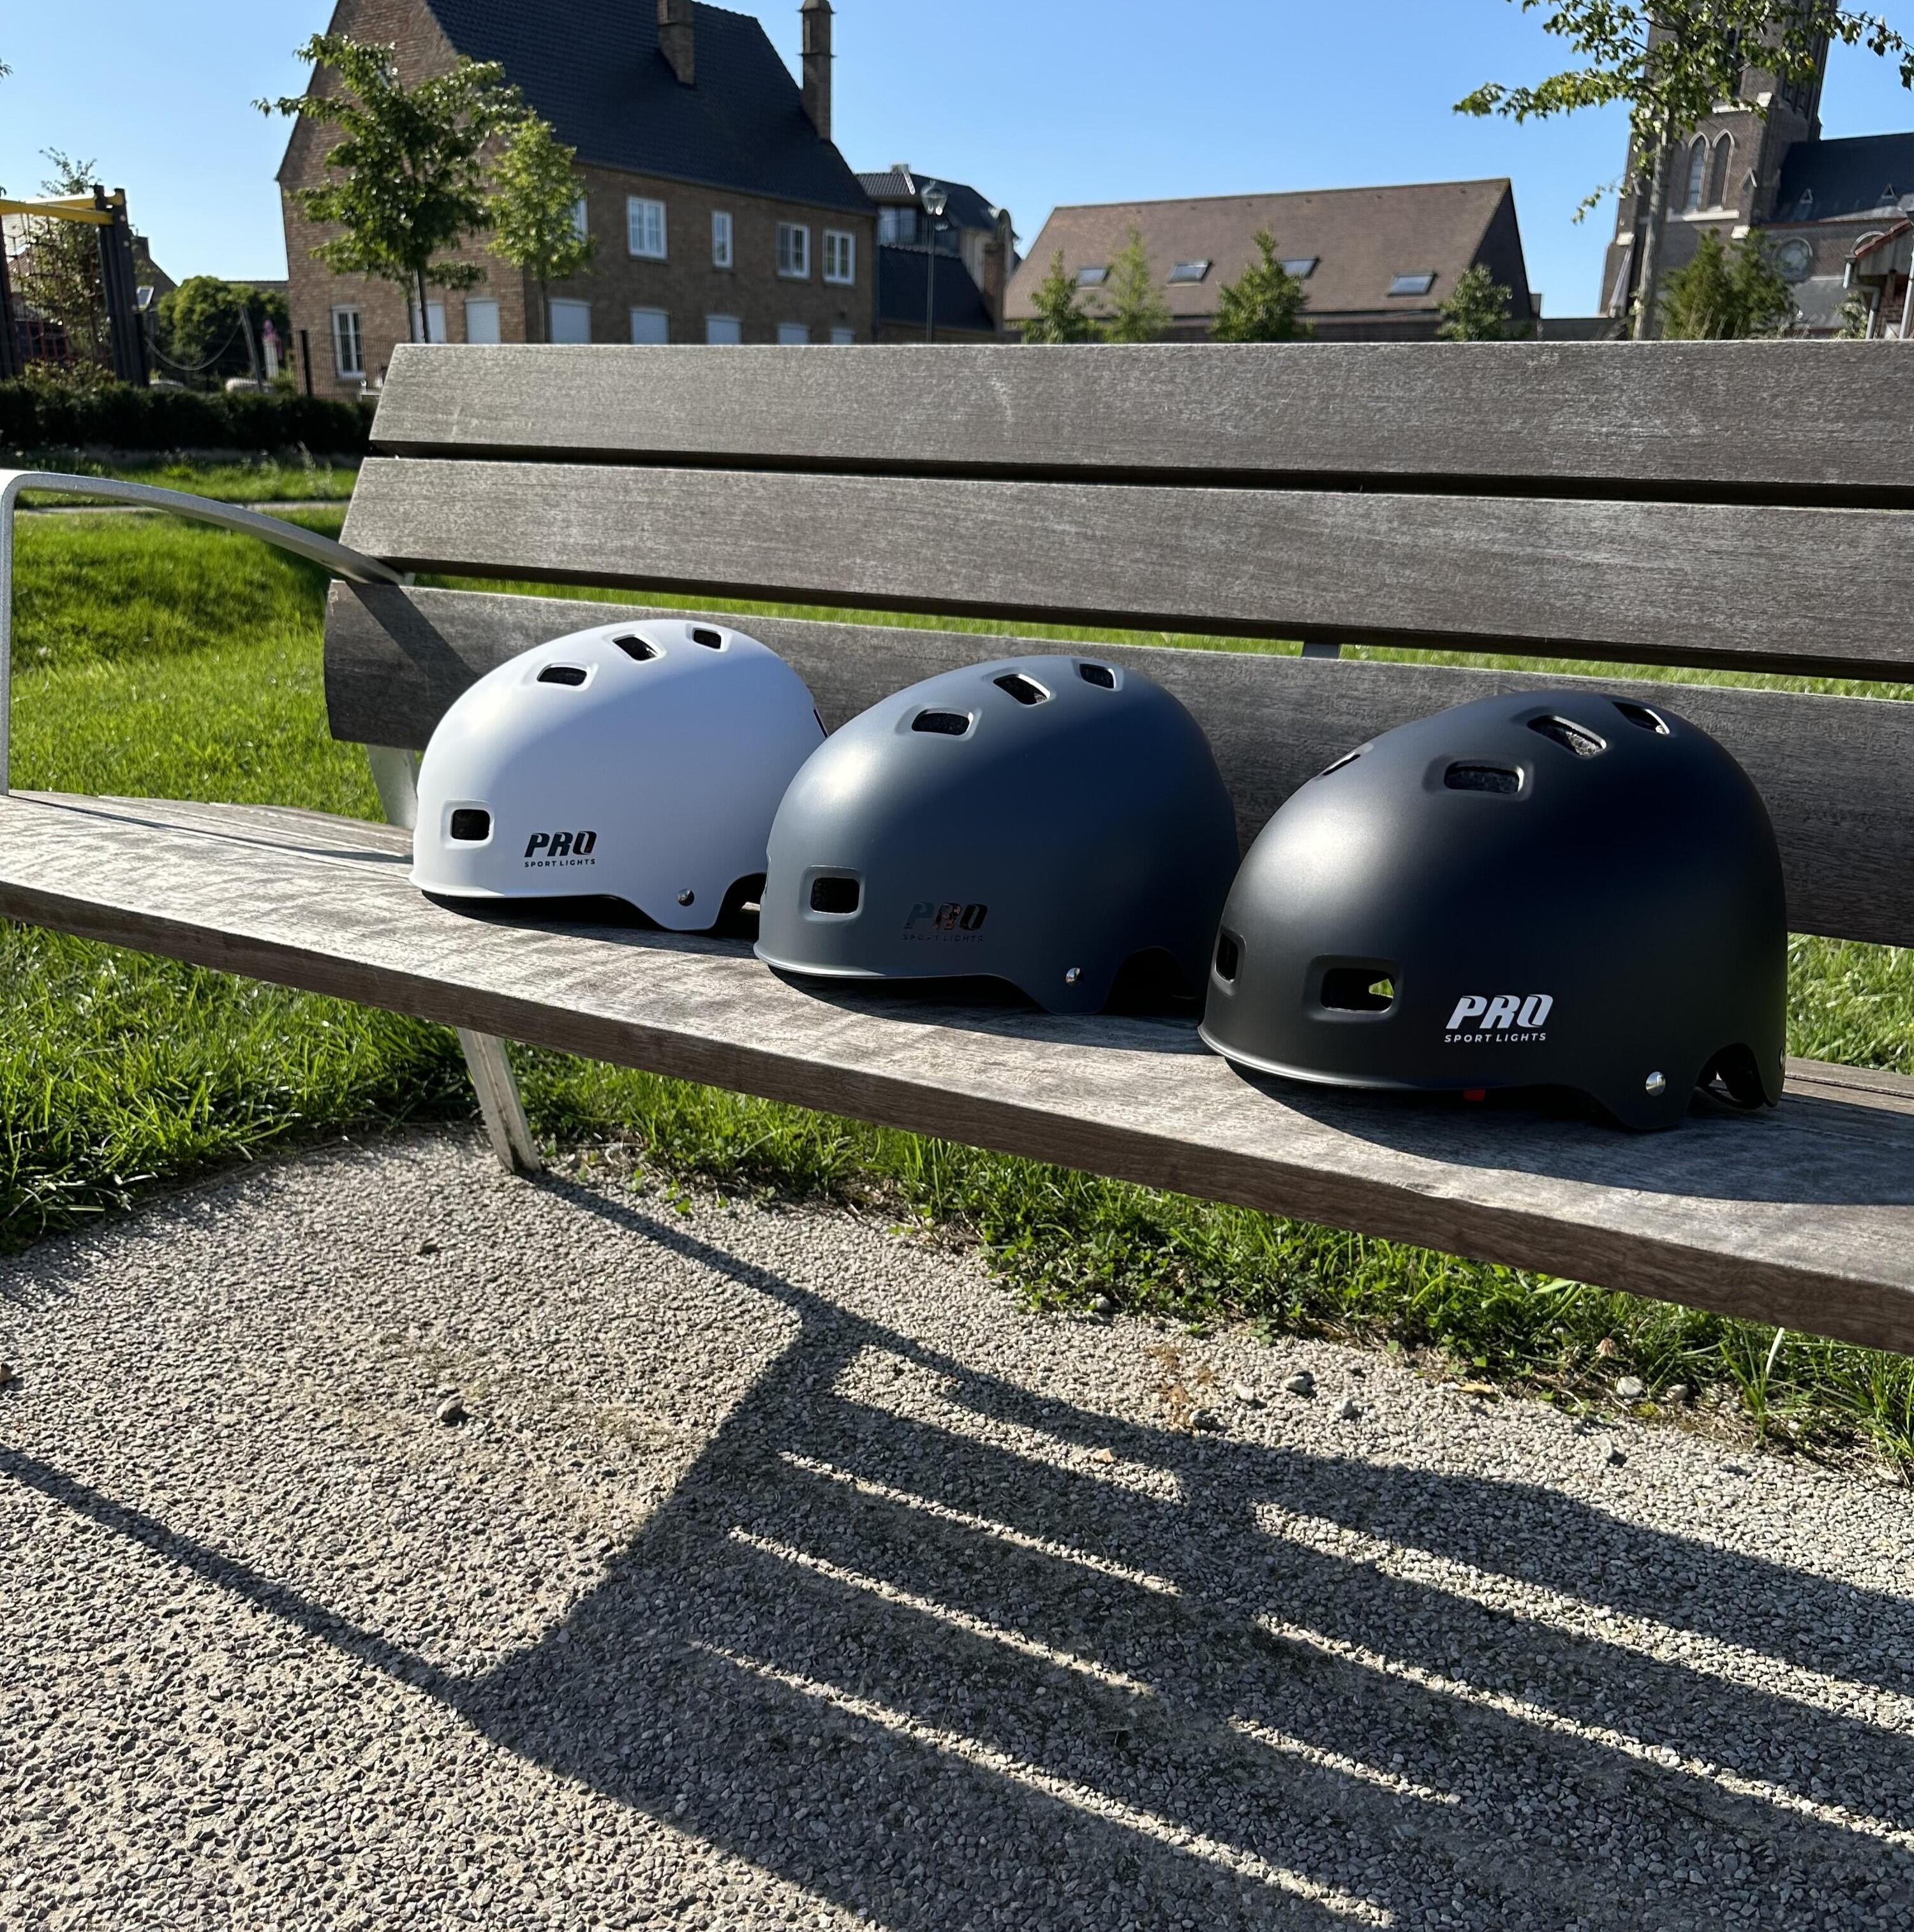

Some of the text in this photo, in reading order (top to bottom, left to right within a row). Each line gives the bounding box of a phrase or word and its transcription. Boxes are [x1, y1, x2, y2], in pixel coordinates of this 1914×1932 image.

[524, 830, 597, 858] PRO
[903, 901, 988, 931] PRO
[1445, 994, 1554, 1029] PRO
[1444, 1033, 1547, 1043] SPORT LIGHTS
